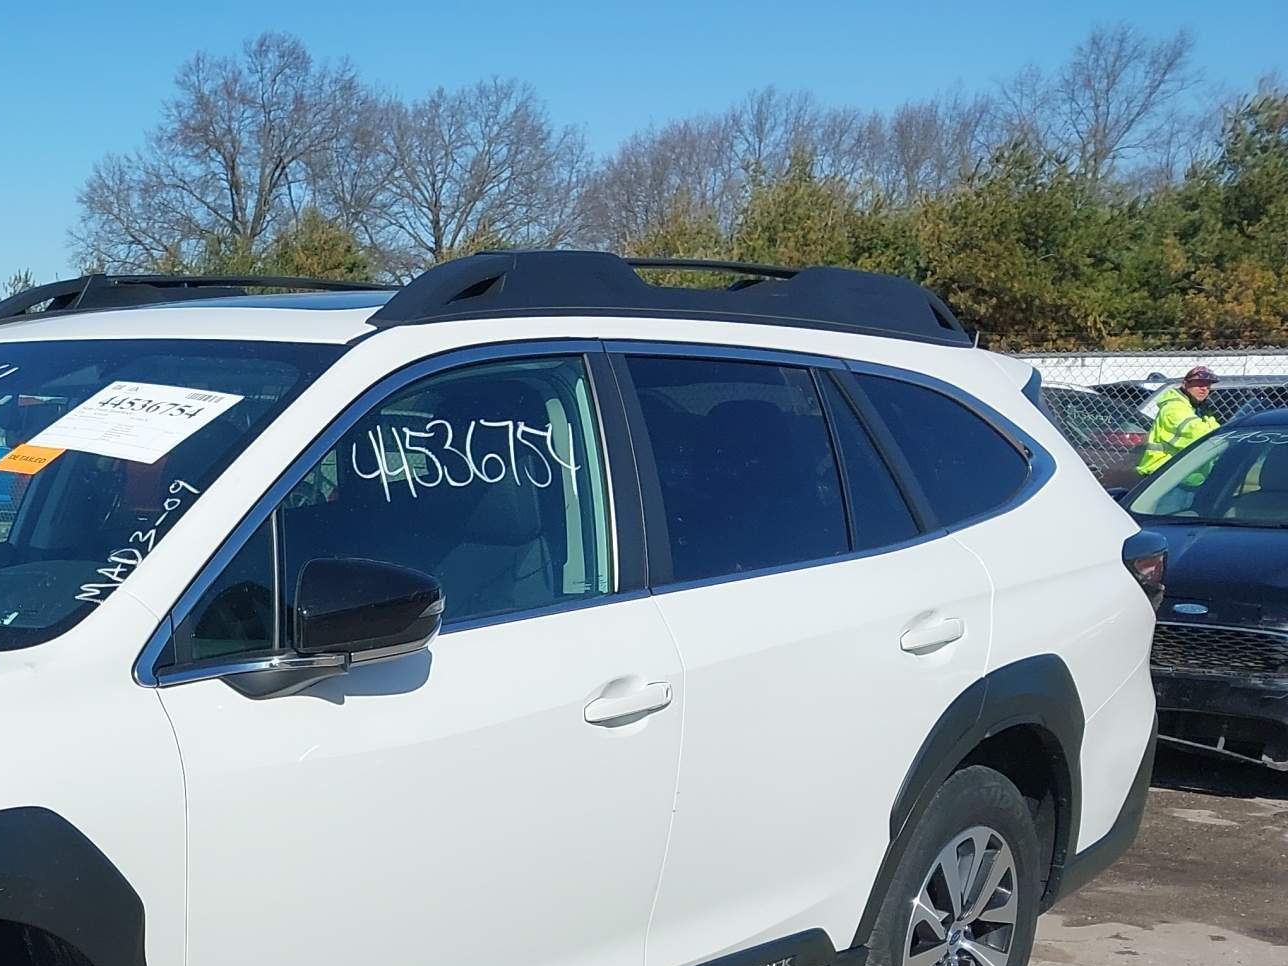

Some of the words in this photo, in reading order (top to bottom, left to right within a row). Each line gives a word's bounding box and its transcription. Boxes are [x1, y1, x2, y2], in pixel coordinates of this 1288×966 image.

[98, 396, 205, 419] 44536754
[8, 454, 47, 464] DETAILED
[352, 419, 582, 503] 44536754
